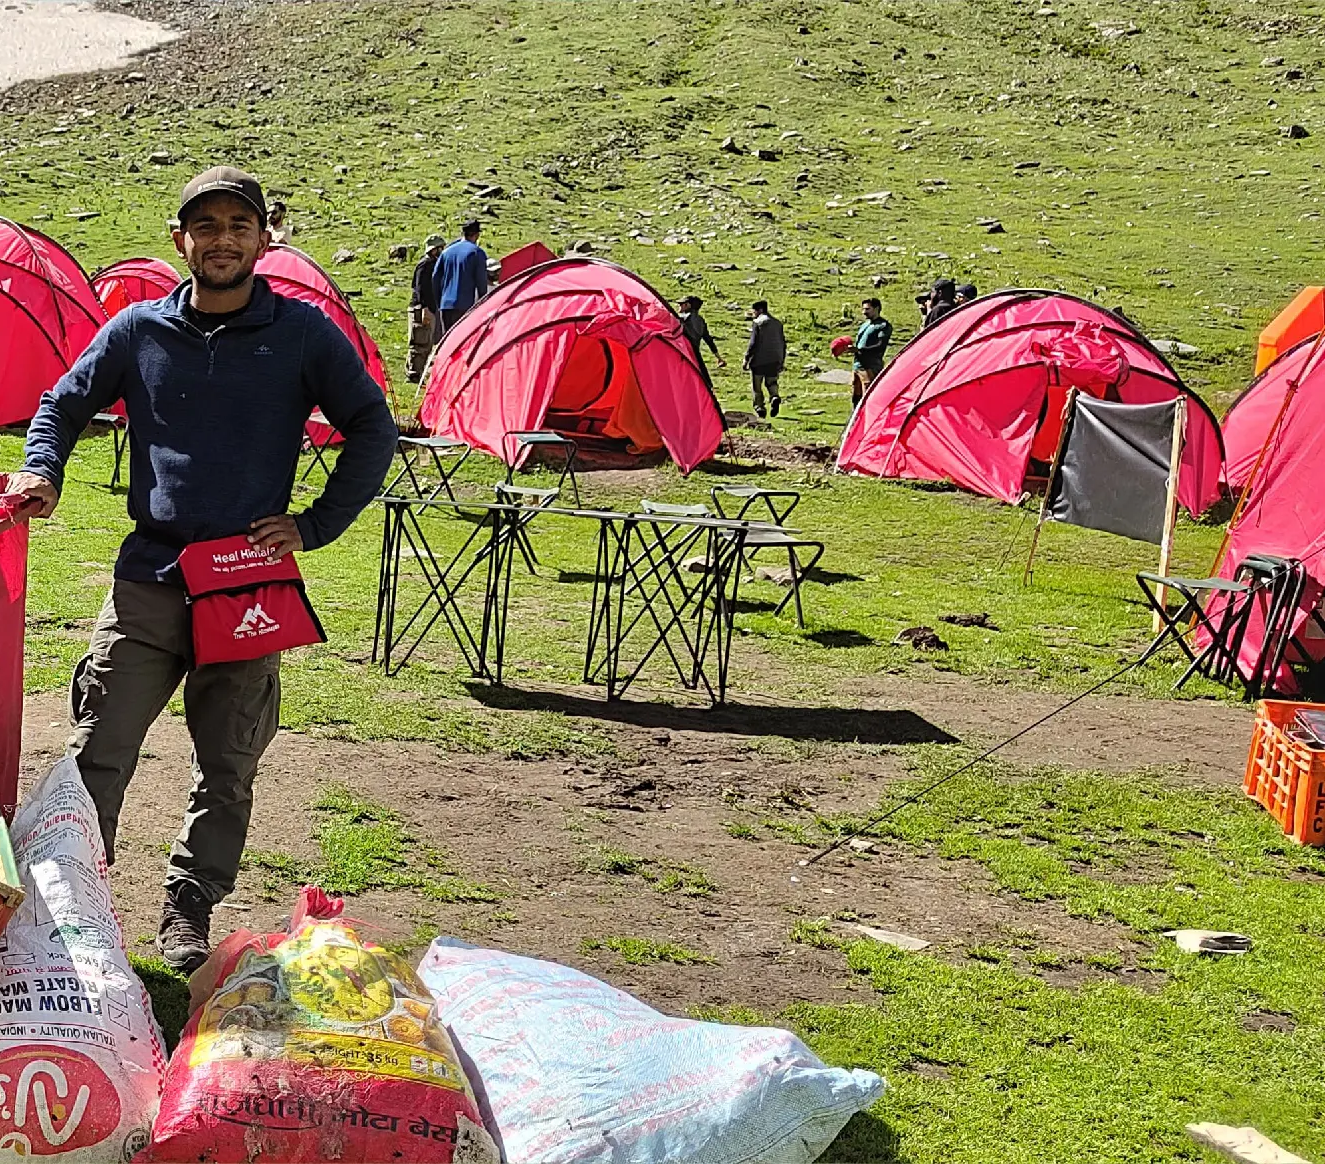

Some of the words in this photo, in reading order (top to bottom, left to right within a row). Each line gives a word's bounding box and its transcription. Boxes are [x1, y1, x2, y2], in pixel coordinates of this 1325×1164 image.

[212, 550, 239, 563] Heal
[38, 994, 103, 1017] ELBOW
[40, 1026, 81, 1039] QUALITY
[82, 1029, 116, 1047] ITALIAN
[367, 1052, 384, 1064] 35
[408, 1117, 457, 1144] बेस
